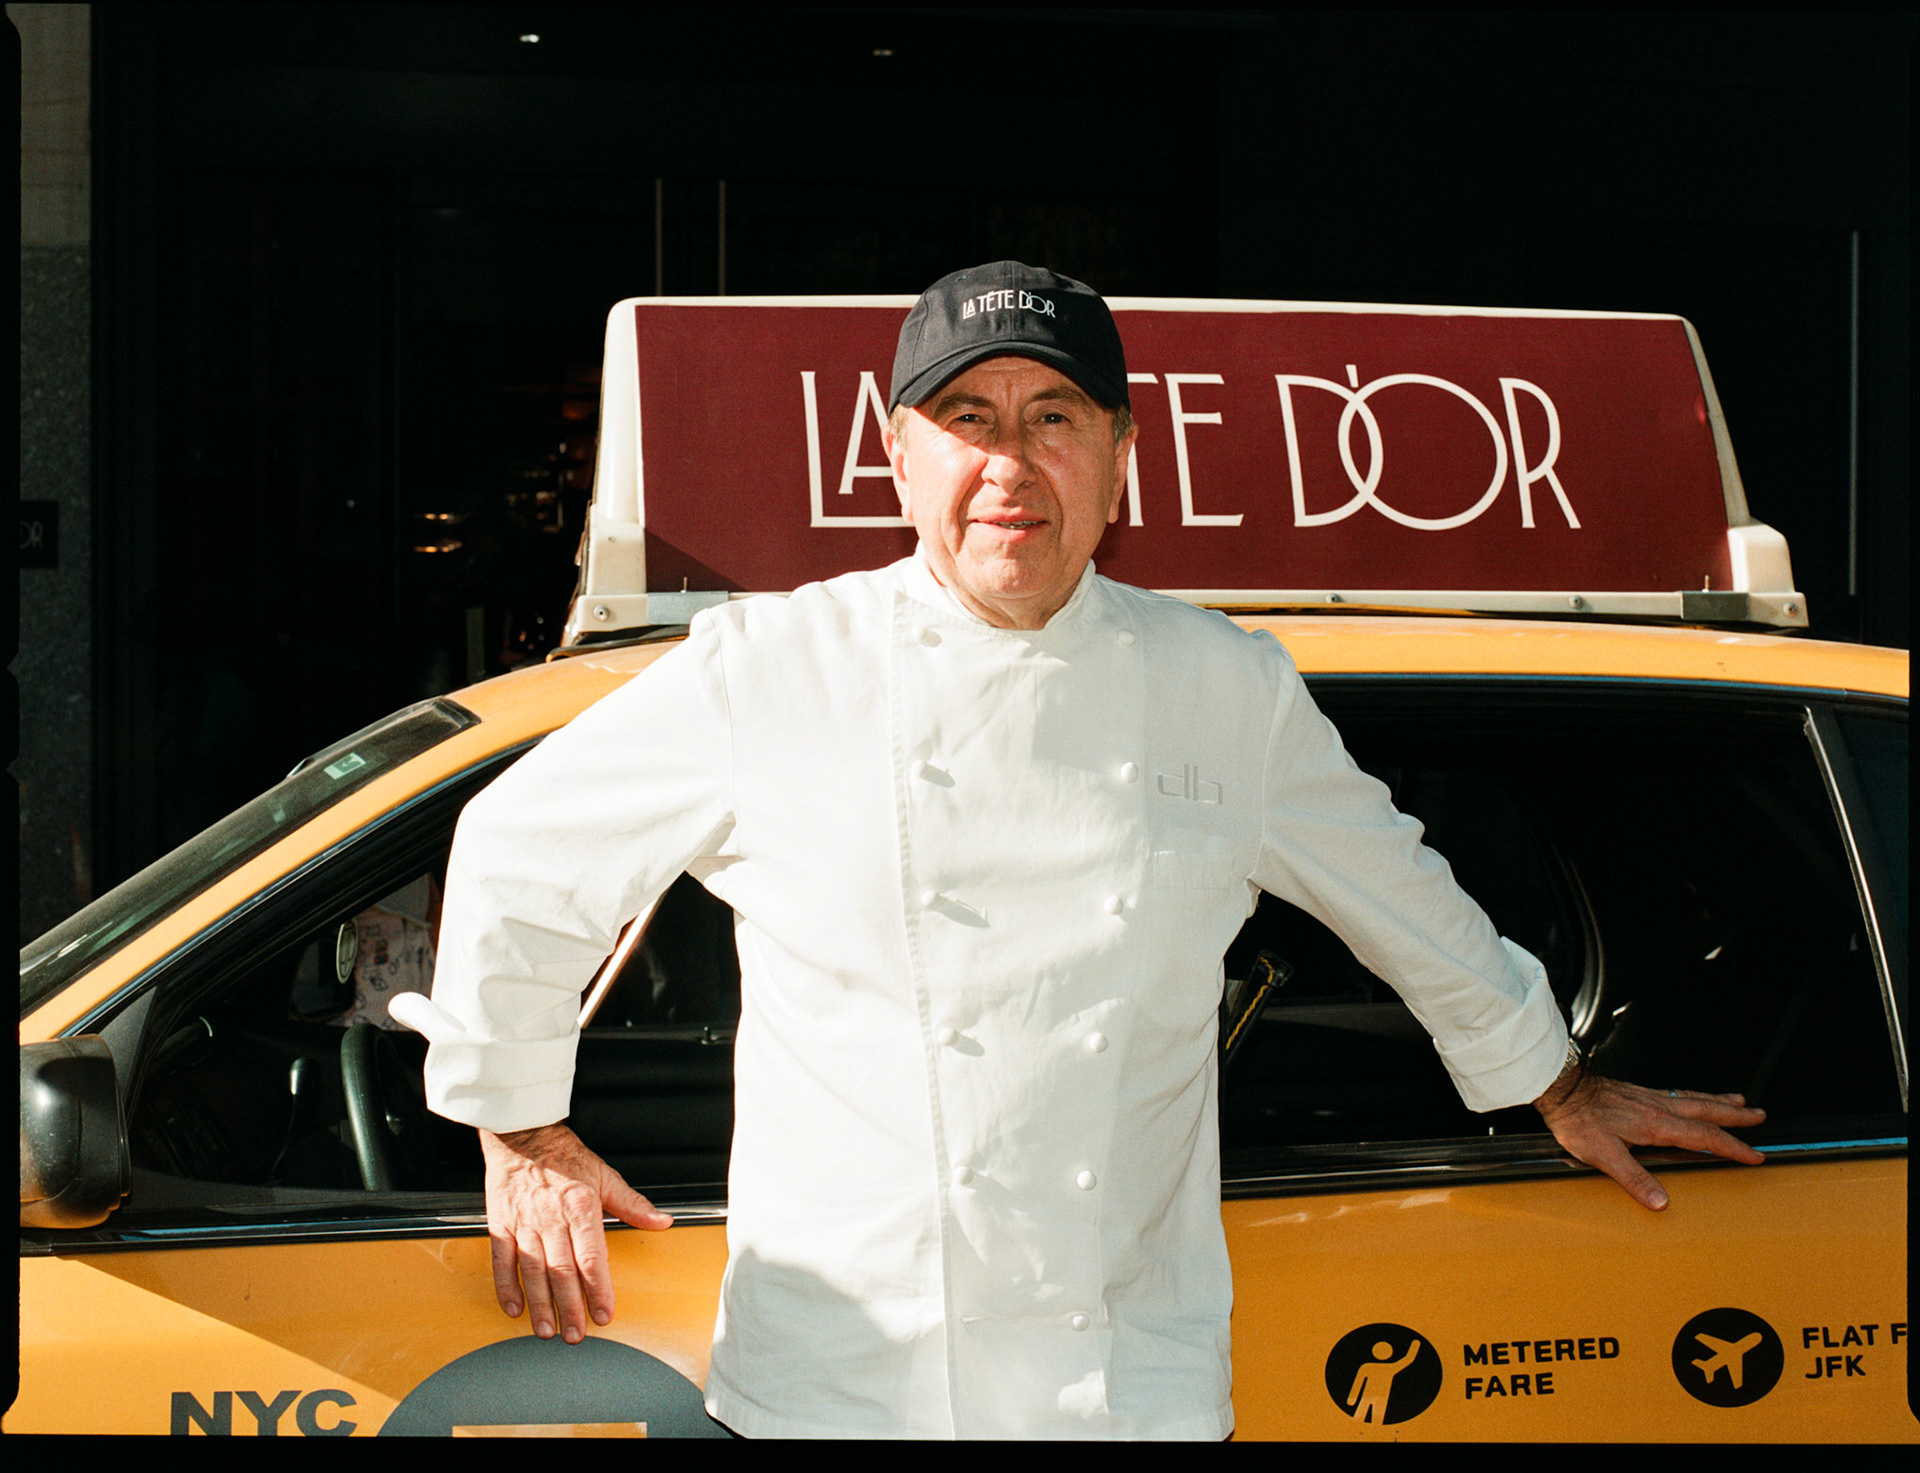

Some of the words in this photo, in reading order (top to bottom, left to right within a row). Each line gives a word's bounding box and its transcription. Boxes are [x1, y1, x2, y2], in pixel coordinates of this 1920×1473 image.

[963, 299, 976, 320] LA
[977, 290, 1015, 313] TÊTE
[1019, 290, 1056, 318] D'OR
[801, 371, 914, 528] LA
[1127, 373, 1244, 526] TE
[1275, 364, 1582, 531] D'OR
[1157, 764, 1223, 805] db
[1802, 1324, 1879, 1349] FLAT
[1463, 1337, 1620, 1366] METERED
[1805, 1354, 1866, 1379] JFK
[1465, 1372, 1555, 1400] FARE
[170, 1389, 358, 1437] NYC
